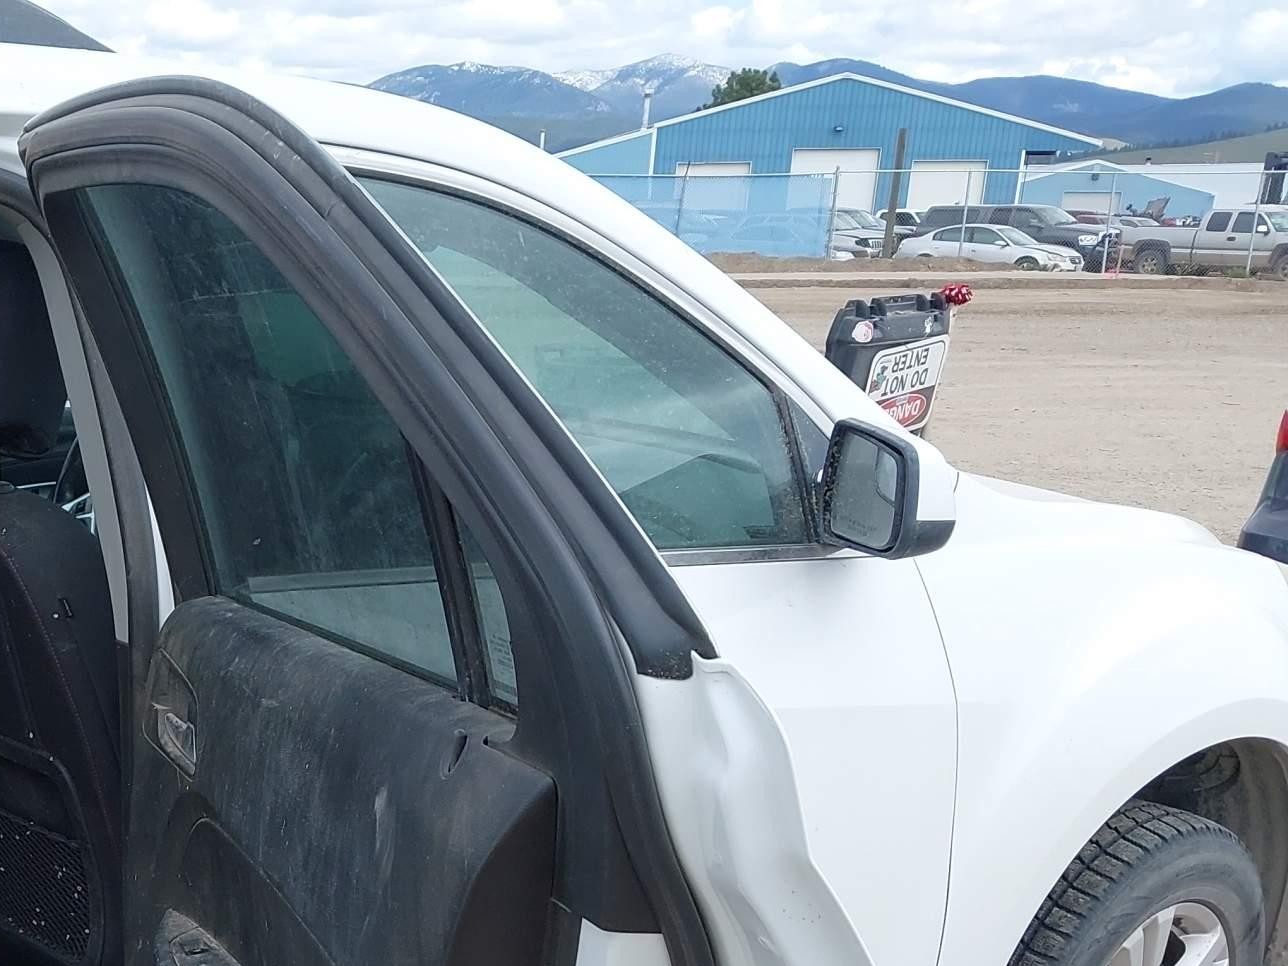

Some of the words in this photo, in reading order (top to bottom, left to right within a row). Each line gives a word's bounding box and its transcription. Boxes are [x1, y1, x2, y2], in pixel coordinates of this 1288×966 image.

[892, 348, 929, 373] ENTER
[881, 375, 908, 397] NOT
[911, 368, 928, 388] DO
[887, 398, 922, 422] DANG
